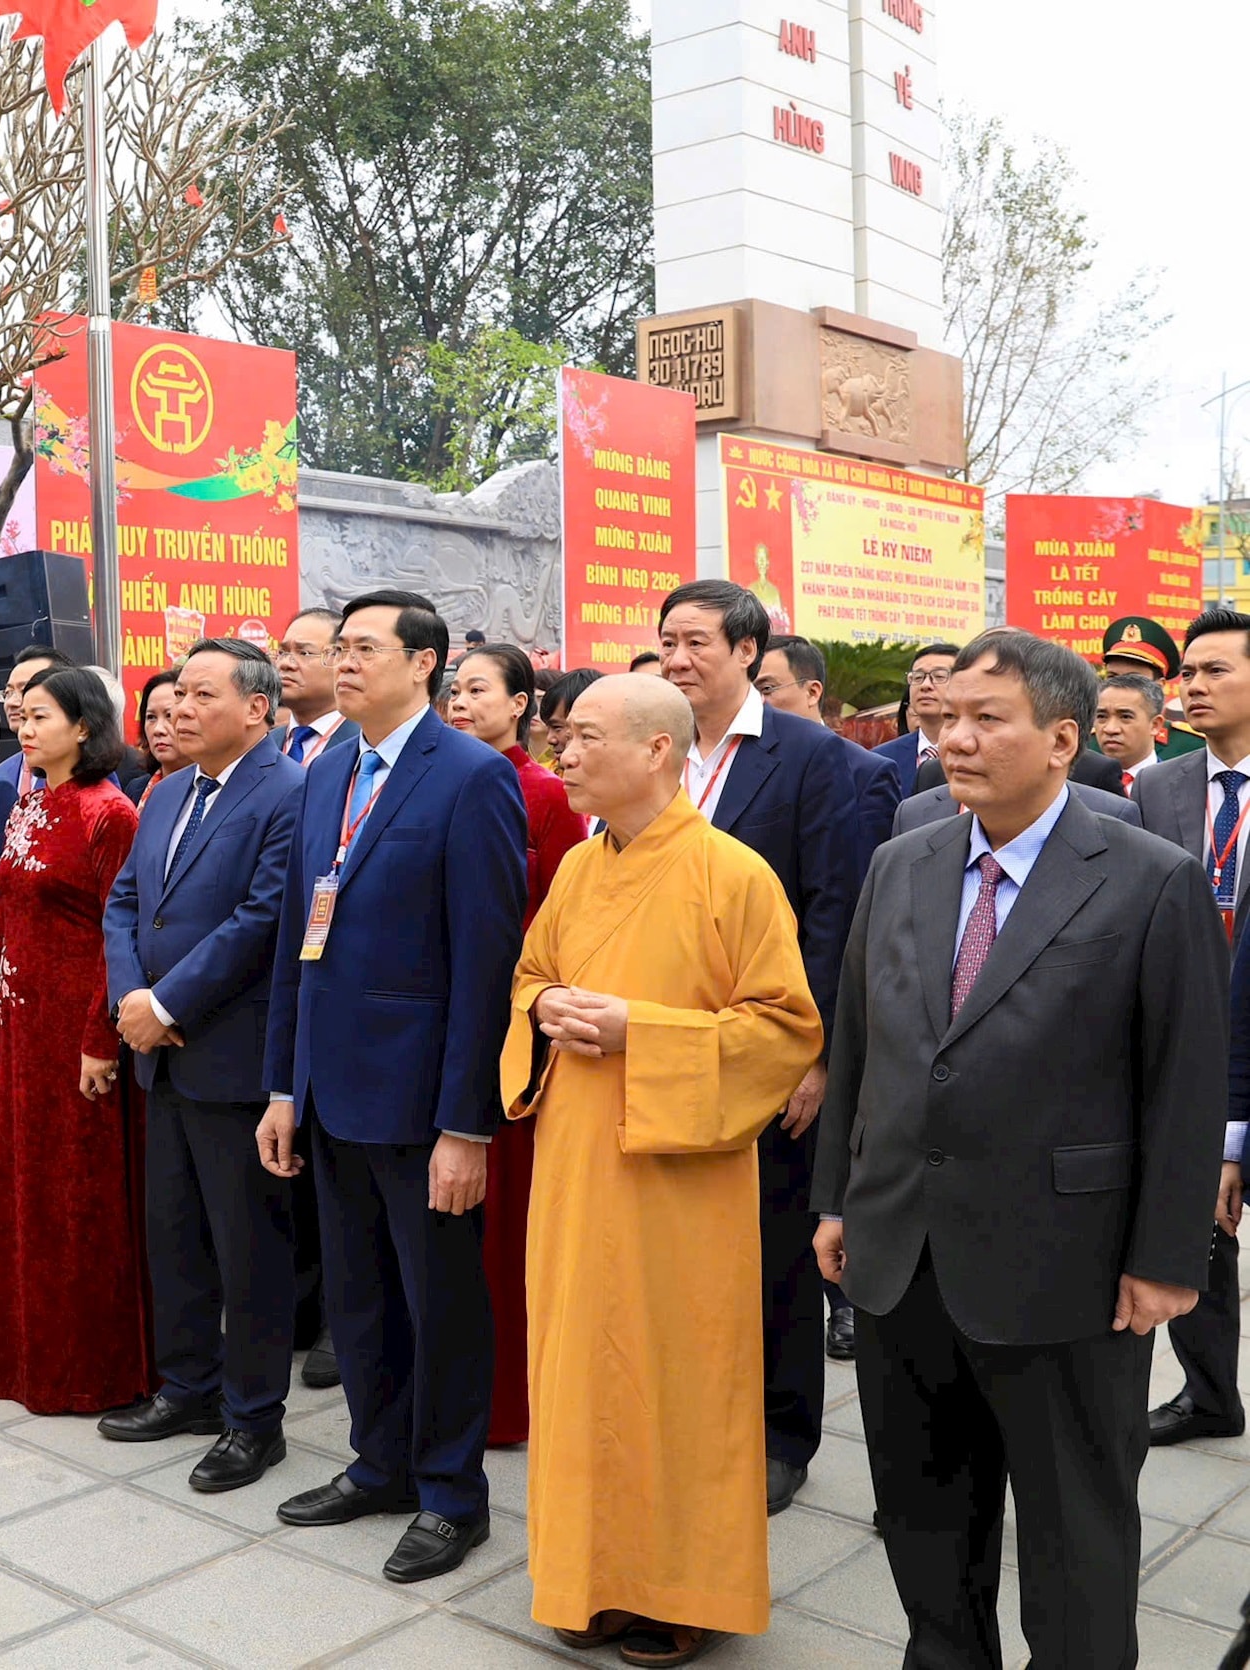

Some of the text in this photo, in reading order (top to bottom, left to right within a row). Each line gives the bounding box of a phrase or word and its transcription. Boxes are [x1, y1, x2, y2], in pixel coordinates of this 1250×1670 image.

[778, 19, 816, 64] ANH
[773, 101, 824, 154] HÙNG
[889, 152, 922, 196] VANG
[593, 447, 671, 481] MỪNG ĐẢNG
[775, 450, 801, 474] CỘNG
[595, 487, 671, 518] QUANG VINH
[51, 516, 93, 553] PHÁ
[153, 522, 225, 563] TRUYỀN
[230, 526, 288, 567] THỐNG
[595, 523, 672, 554] MỪNG XUÂN
[1034, 538, 1116, 558] MÙA XUÂN
[586, 561, 681, 594] BÍNH NGỌ 2026
[1050, 563, 1100, 582] LÀ TẾT
[179, 583, 218, 614] ANH
[222, 580, 271, 617] HÙNG
[582, 598, 622, 625] MỪNG
[625, 600, 651, 627] ĐẤT
[1087, 588, 1118, 607] CÂY
[1042, 613, 1110, 631] LÀM CHO
[591, 637, 631, 664] MỪNG
